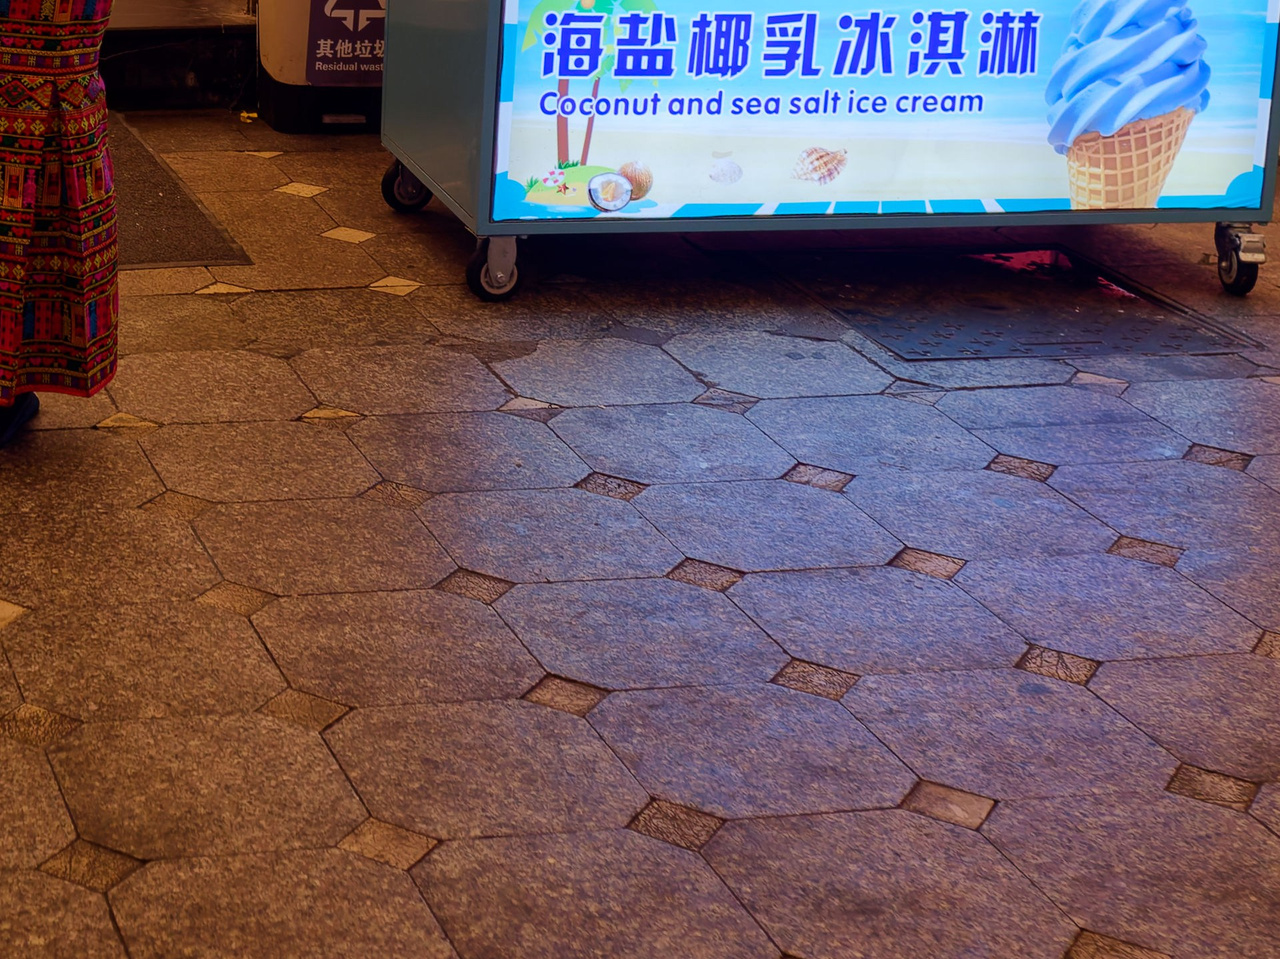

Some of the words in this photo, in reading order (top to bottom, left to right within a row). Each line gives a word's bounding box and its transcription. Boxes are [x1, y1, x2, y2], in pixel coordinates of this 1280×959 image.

[541, 10, 1041, 79] 海盐椰乳冰淇淋
[315, 61, 358, 71] Residual
[360, 62, 385, 71] wast
[539, 91, 661, 117] Coconut
[667, 90, 721, 116] and
[731, 95, 781, 115] sea
[789, 90, 840, 115] salt
[847, 90, 887, 114] ice
[895, 93, 984, 114] cream
